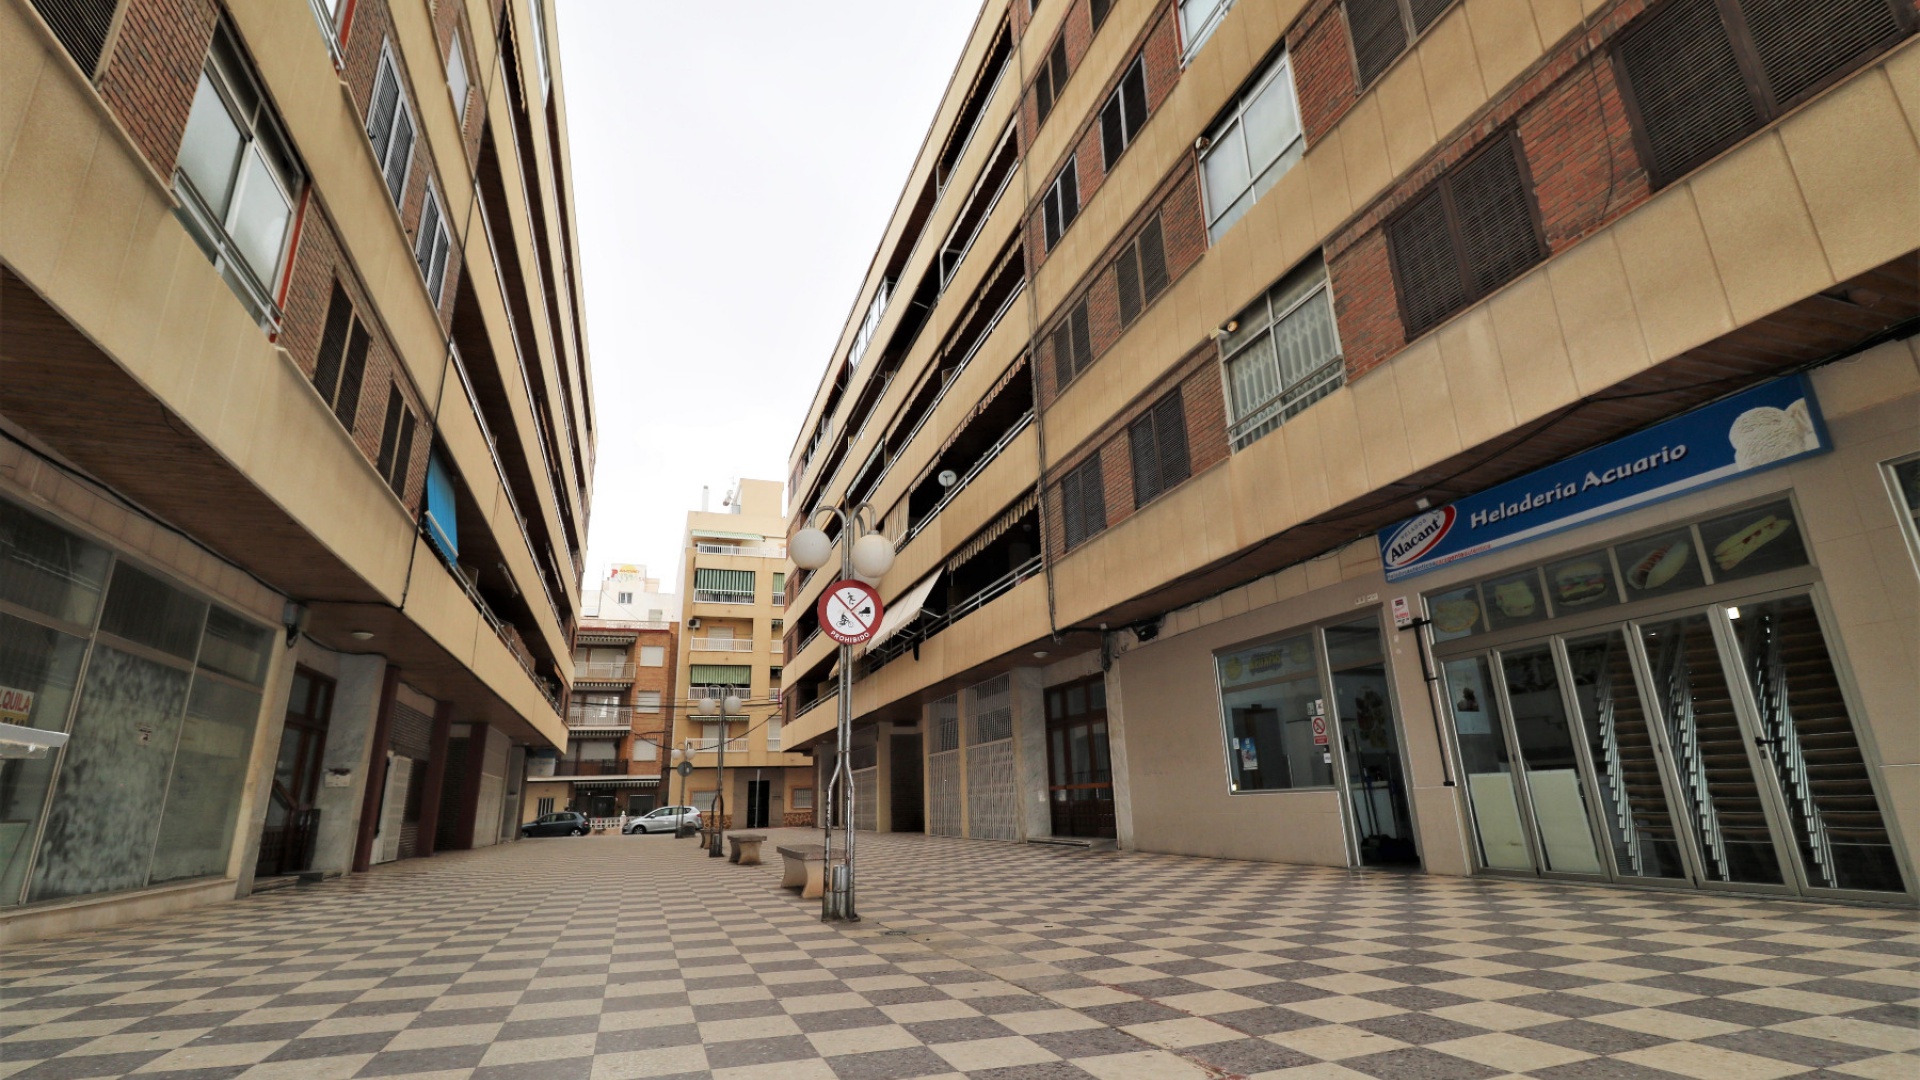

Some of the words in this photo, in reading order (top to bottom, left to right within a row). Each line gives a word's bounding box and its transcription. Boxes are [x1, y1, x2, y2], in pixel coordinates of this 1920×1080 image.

[1470, 483, 1577, 529] Heladería
[1581, 444, 1687, 491] Acuario
[1390, 519, 1441, 562] Alacant
[830, 630, 870, 642] PROHIBIDO
